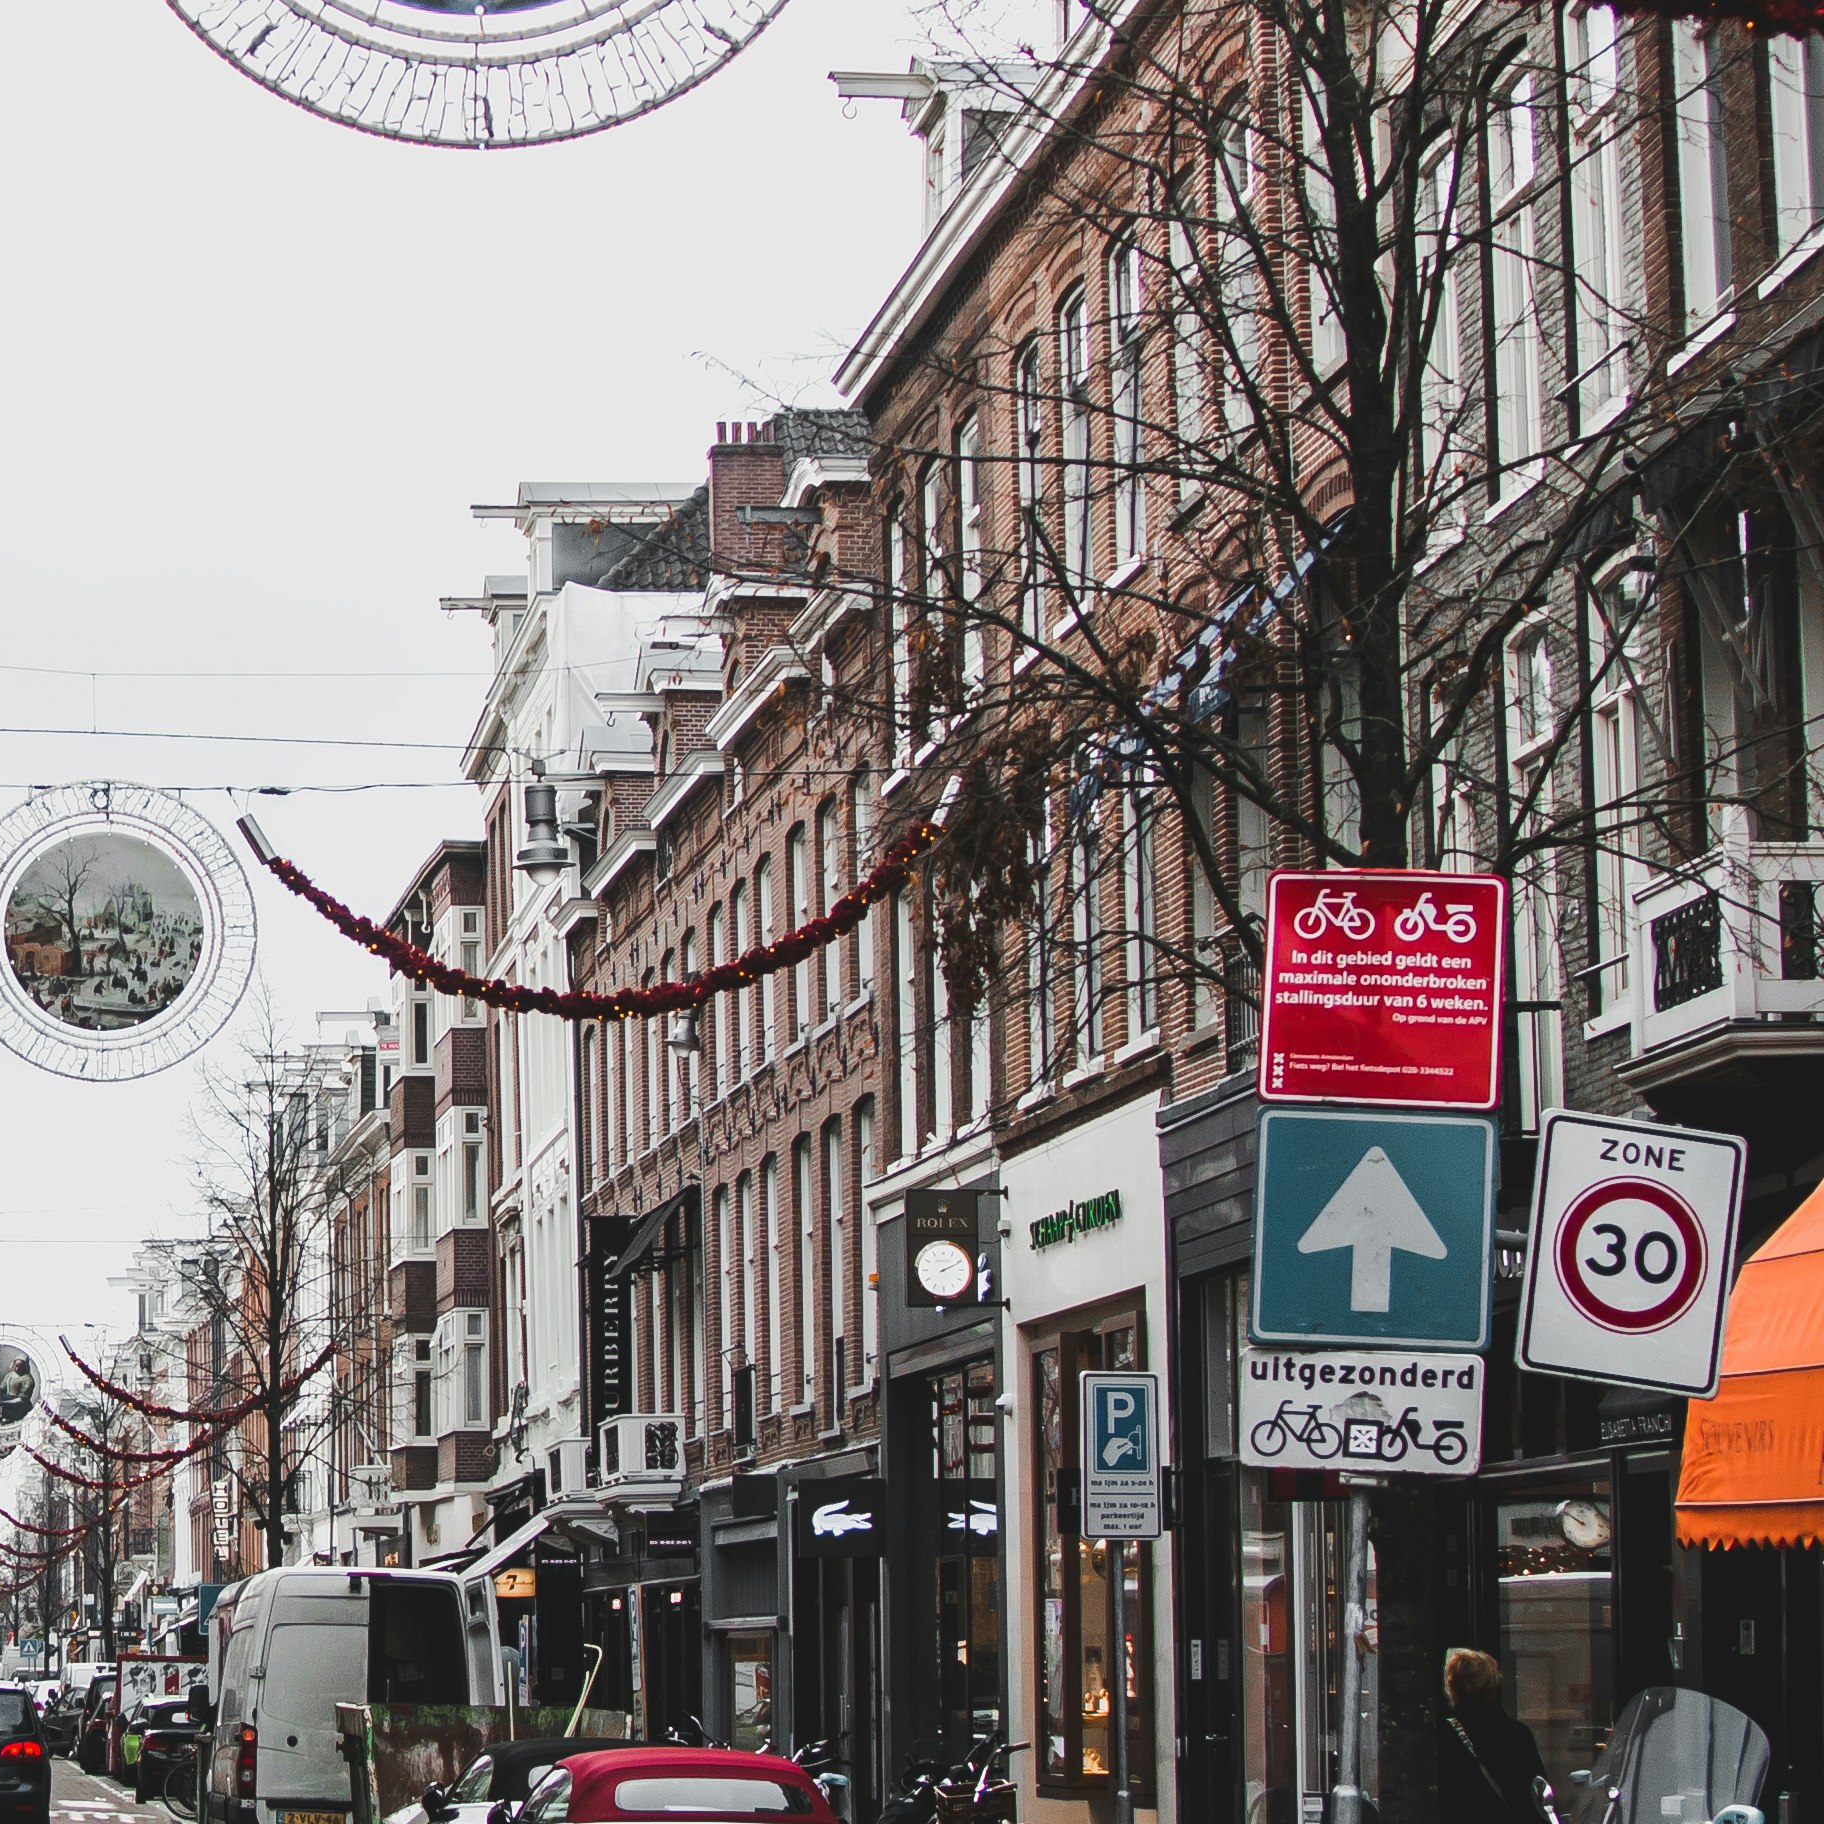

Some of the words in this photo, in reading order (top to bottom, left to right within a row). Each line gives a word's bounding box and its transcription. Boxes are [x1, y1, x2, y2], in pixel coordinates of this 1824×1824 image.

[1291, 949, 1308, 964] In
[1310, 950, 1333, 966] dit
[1336, 951, 1392, 968] gebied
[1395, 952, 1438, 970] geldt
[1441, 955, 1471, 969] een
[1278, 971, 1356, 985] maximale
[1359, 972, 1487, 990] ononderbroken
[1275, 990, 1380, 1008] stallingsduur
[1383, 995, 1413, 1008] van
[1416, 994, 1428, 1008] 6
[1430, 995, 1489, 1011] weken.
[1392, 1012, 1406, 1024] Op
[1407, 1014, 1436, 1025] grond
[1436, 1016, 1454, 1024] van
[1454, 1015, 1467, 1025] de
[1467, 1016, 1488, 1026] APV
[1599, 1137, 1686, 1172] ZONE
[916, 1216, 969, 1229] ROLEX
[1584, 1223, 1678, 1284] 30
[1250, 1355, 1475, 1391] uitgezonderd
[1106, 1391, 1135, 1434] P
